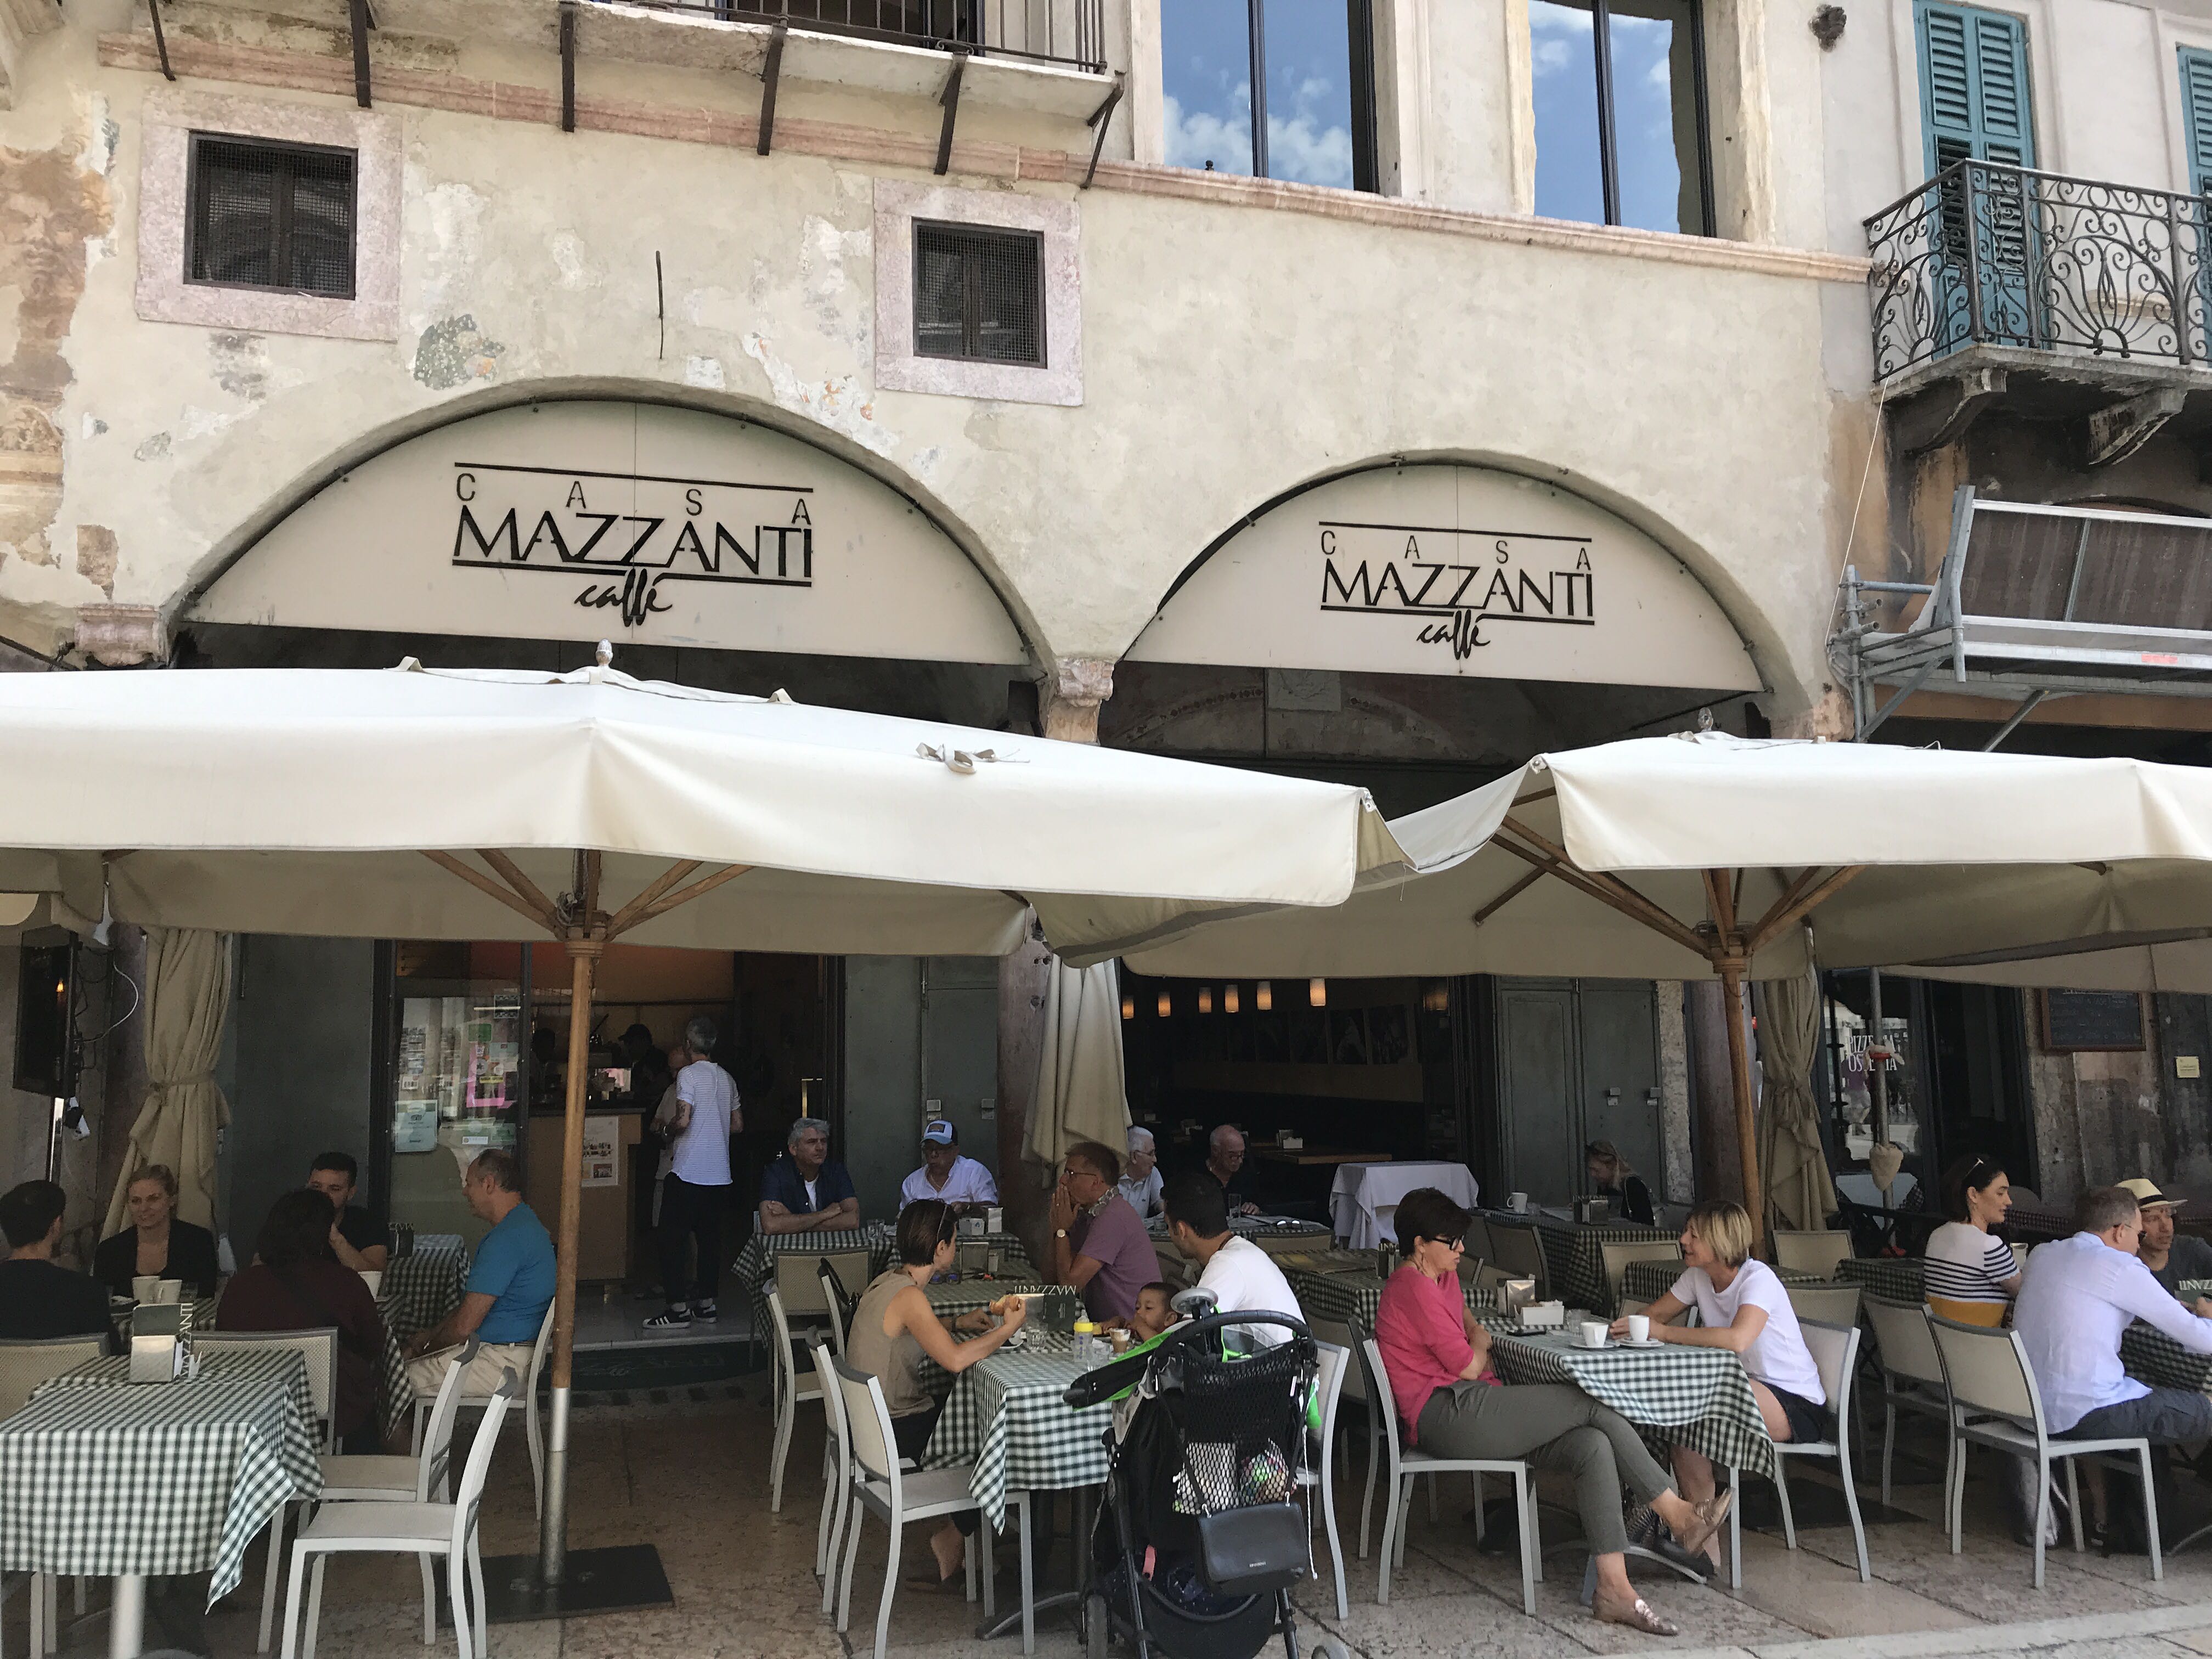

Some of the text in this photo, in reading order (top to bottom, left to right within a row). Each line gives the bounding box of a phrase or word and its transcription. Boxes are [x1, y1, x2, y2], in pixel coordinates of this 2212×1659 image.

[456, 473, 811, 525] CASA
[453, 505, 812, 578] MAZZANTI
[1321, 530, 1591, 571] CASA
[1322, 558, 1593, 617] MAZZANTI
[1848, 1053, 1897, 1071] OSEIA
[1850, 1035, 1896, 1053] PIZZA
